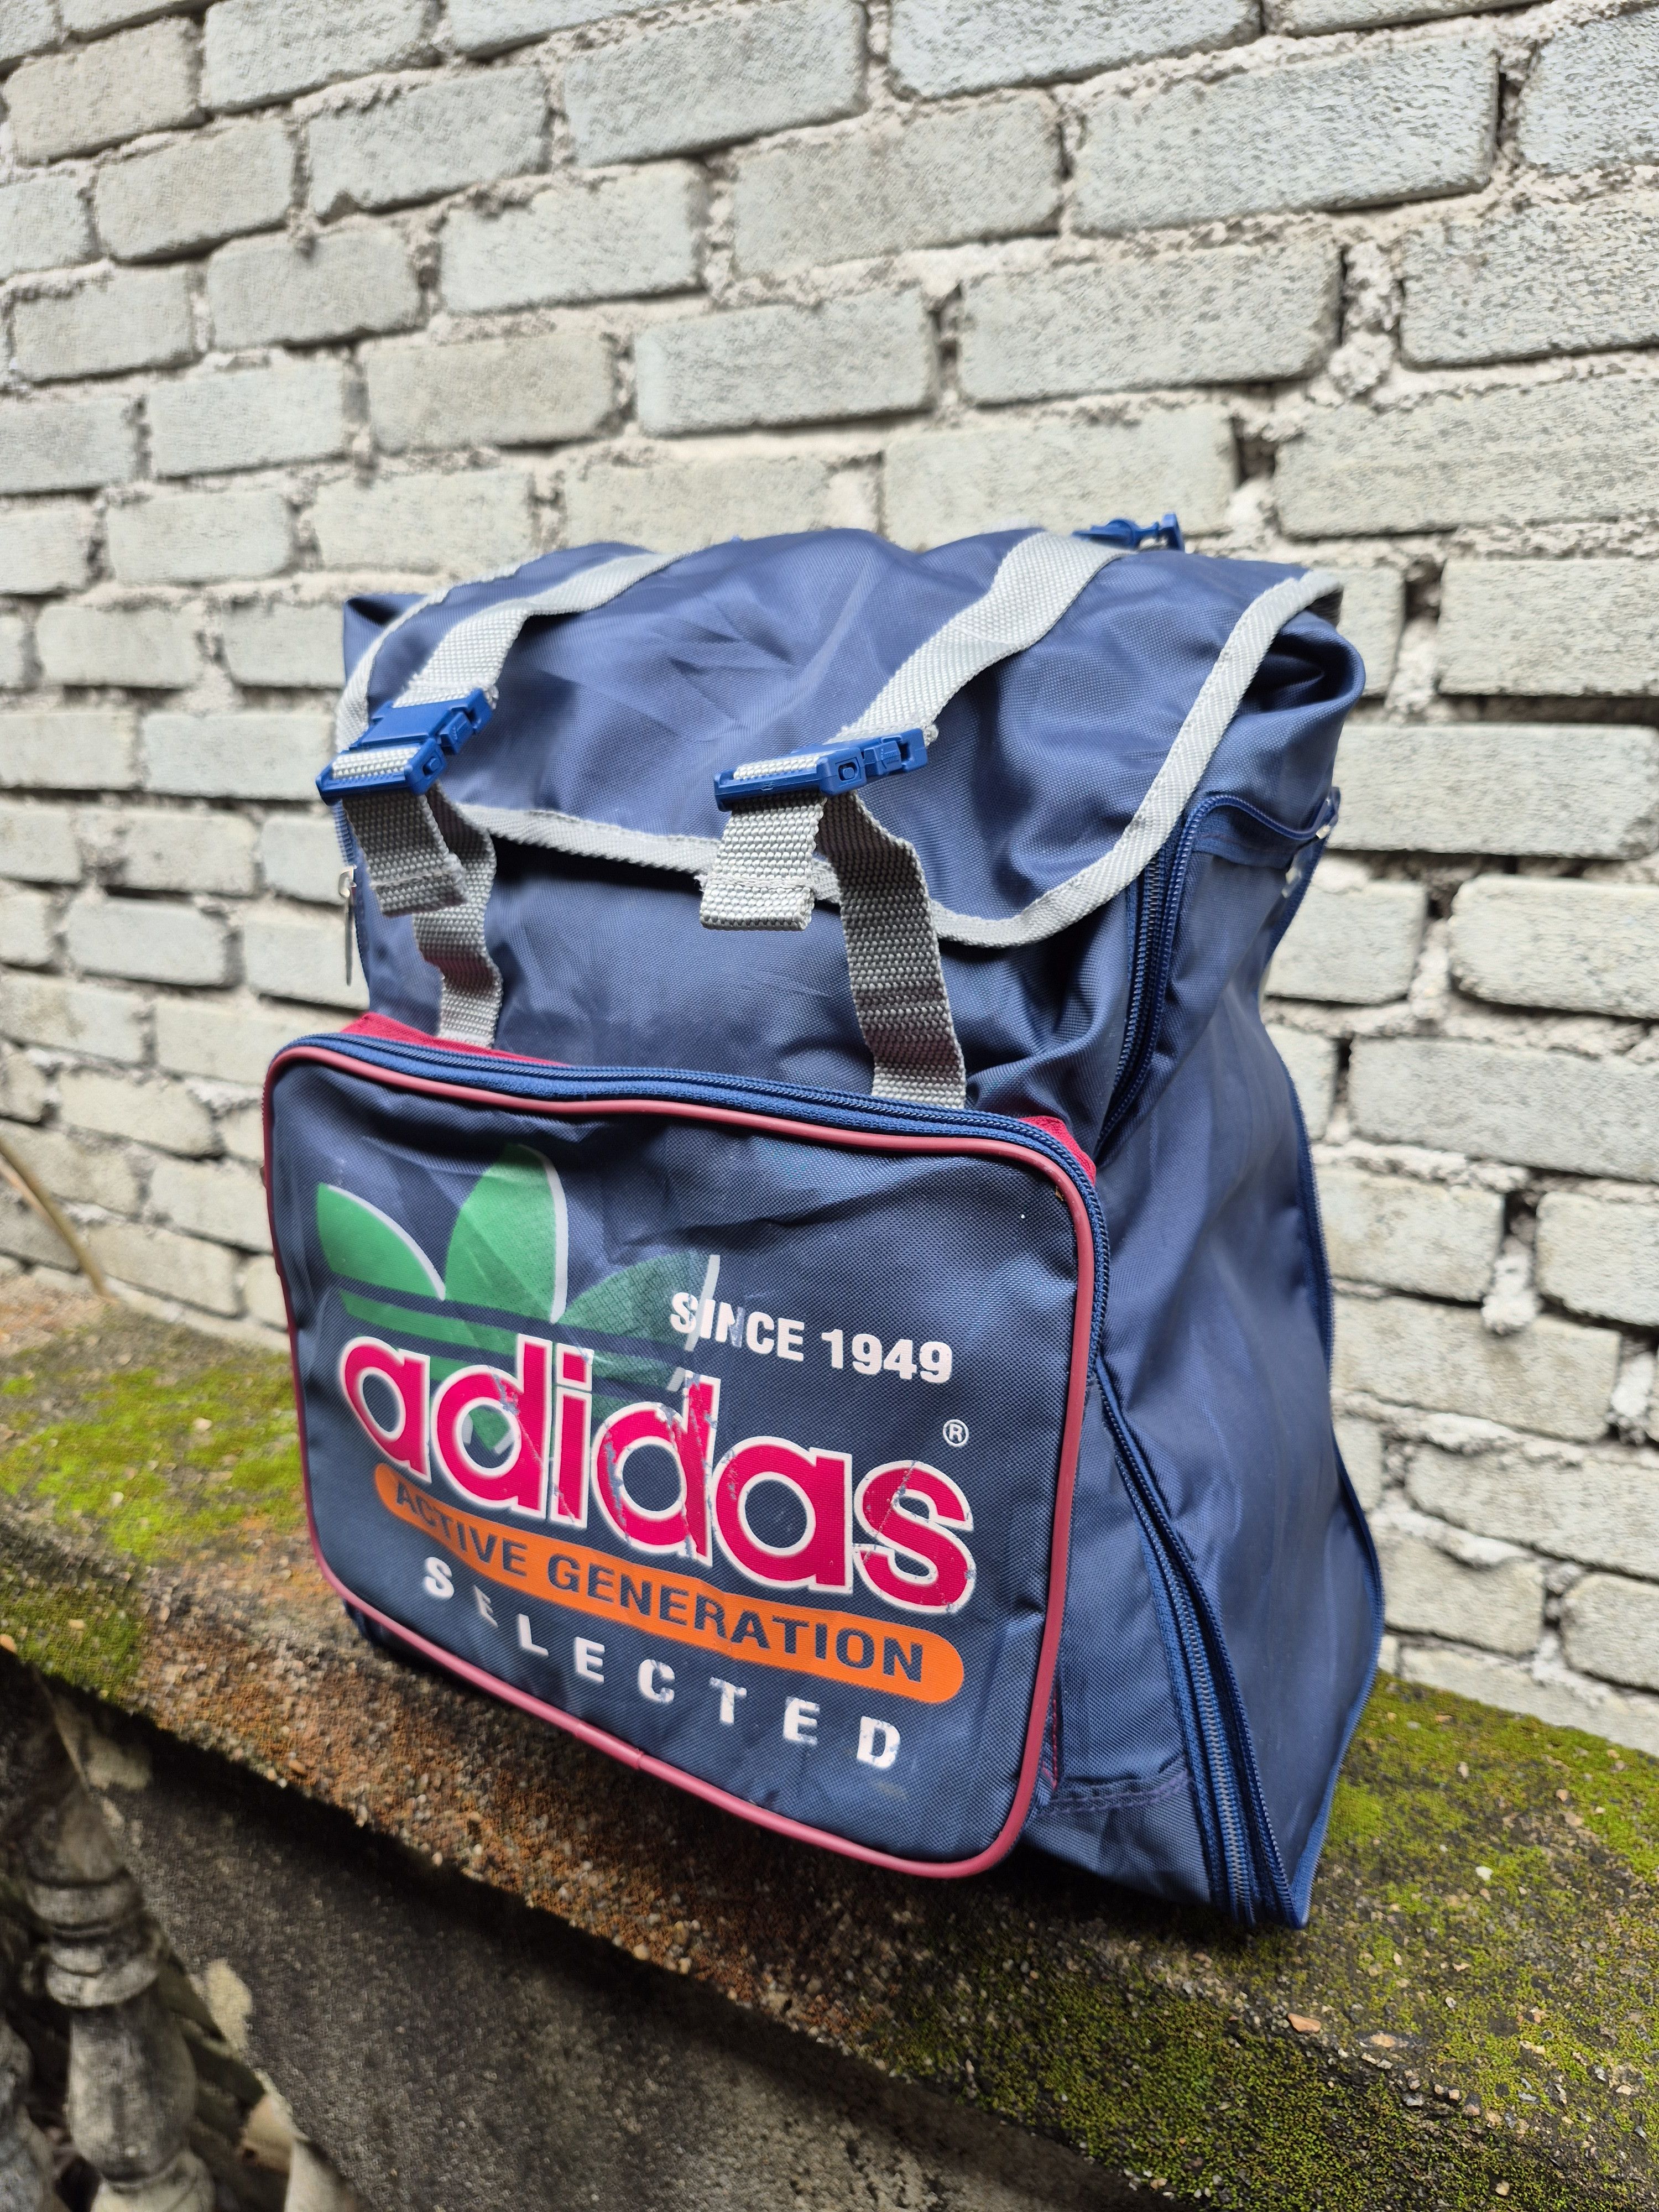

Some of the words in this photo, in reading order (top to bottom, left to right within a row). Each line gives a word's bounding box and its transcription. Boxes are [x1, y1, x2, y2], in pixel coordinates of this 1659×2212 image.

[670, 1292, 805, 1361] SINCE
[822, 1329, 953, 1383] 1949
[339, 1333, 976, 1613] adidas
[396, 1482, 527, 1577] ACTIVE
[547, 1553, 924, 1683] GENERATION
[423, 1557, 901, 1769] SELECTED
